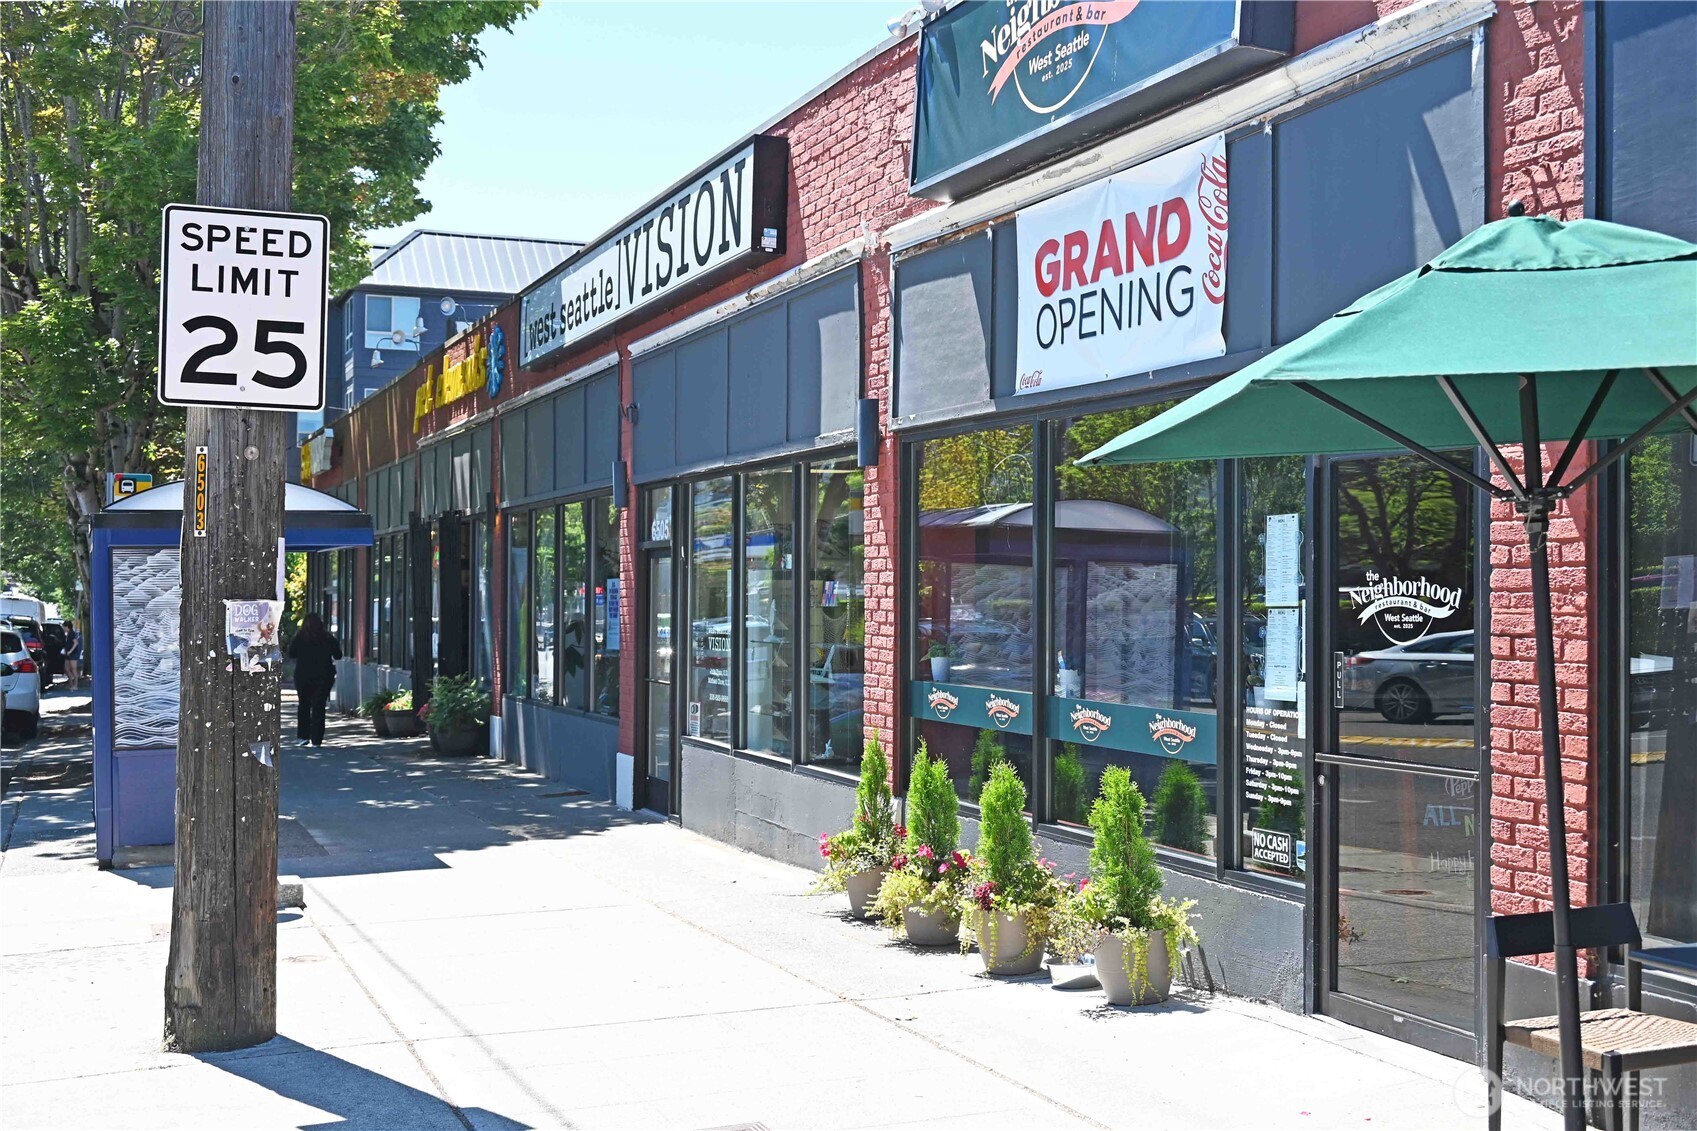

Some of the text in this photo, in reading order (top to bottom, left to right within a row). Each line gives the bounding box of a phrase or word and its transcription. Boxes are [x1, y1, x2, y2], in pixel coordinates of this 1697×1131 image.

[1015, 4, 1106, 60] restaurant & bar
[1028, 30, 1090, 75] West Seattle
[1041, 58, 1073, 83] est. 2025
[180, 222, 312, 258] SPEED
[622, 157, 746, 305] VISION
[1034, 196, 1191, 298] GRAND
[191, 263, 299, 298] LIMIT
[1036, 265, 1195, 349] OPENING
[180, 315, 307, 389] 25
[196, 454, 206, 530] 6503
[1365, 569, 1380, 582] the
[1349, 575, 1462, 610] Neighborhood
[234, 603, 259, 617] DOG
[1374, 599, 1412, 610] restaurant
[1419, 603, 1431, 614] bar
[1384, 613, 1424, 623] West Seattle
[1070, 707, 1112, 727] Neighborhood
[1245, 706, 1264, 715] HOURS
[1272, 709, 1300, 719] OPERATIO
[1149, 717, 1197, 738] Neighborhood
[1245, 718, 1265, 729] Monday
[1269, 720, 1287, 730] Closed
[1245, 730, 1266, 741] Tuesday
[1270, 733, 1288, 743] Closed
[1245, 742, 1274, 754] Wednesday
[1245, 754, 1269, 766] Thursday
[1245, 766, 1261, 777] Friday
[1245, 779, 1268, 790] Saturday
[1245, 791, 1264, 802] Sunday
[1423, 804, 1461, 827] ALL
[1253, 831, 1289, 853] NO CASH
[1254, 847, 1289, 864] ACCEPTED
[1430, 851, 1466, 875] Happy
